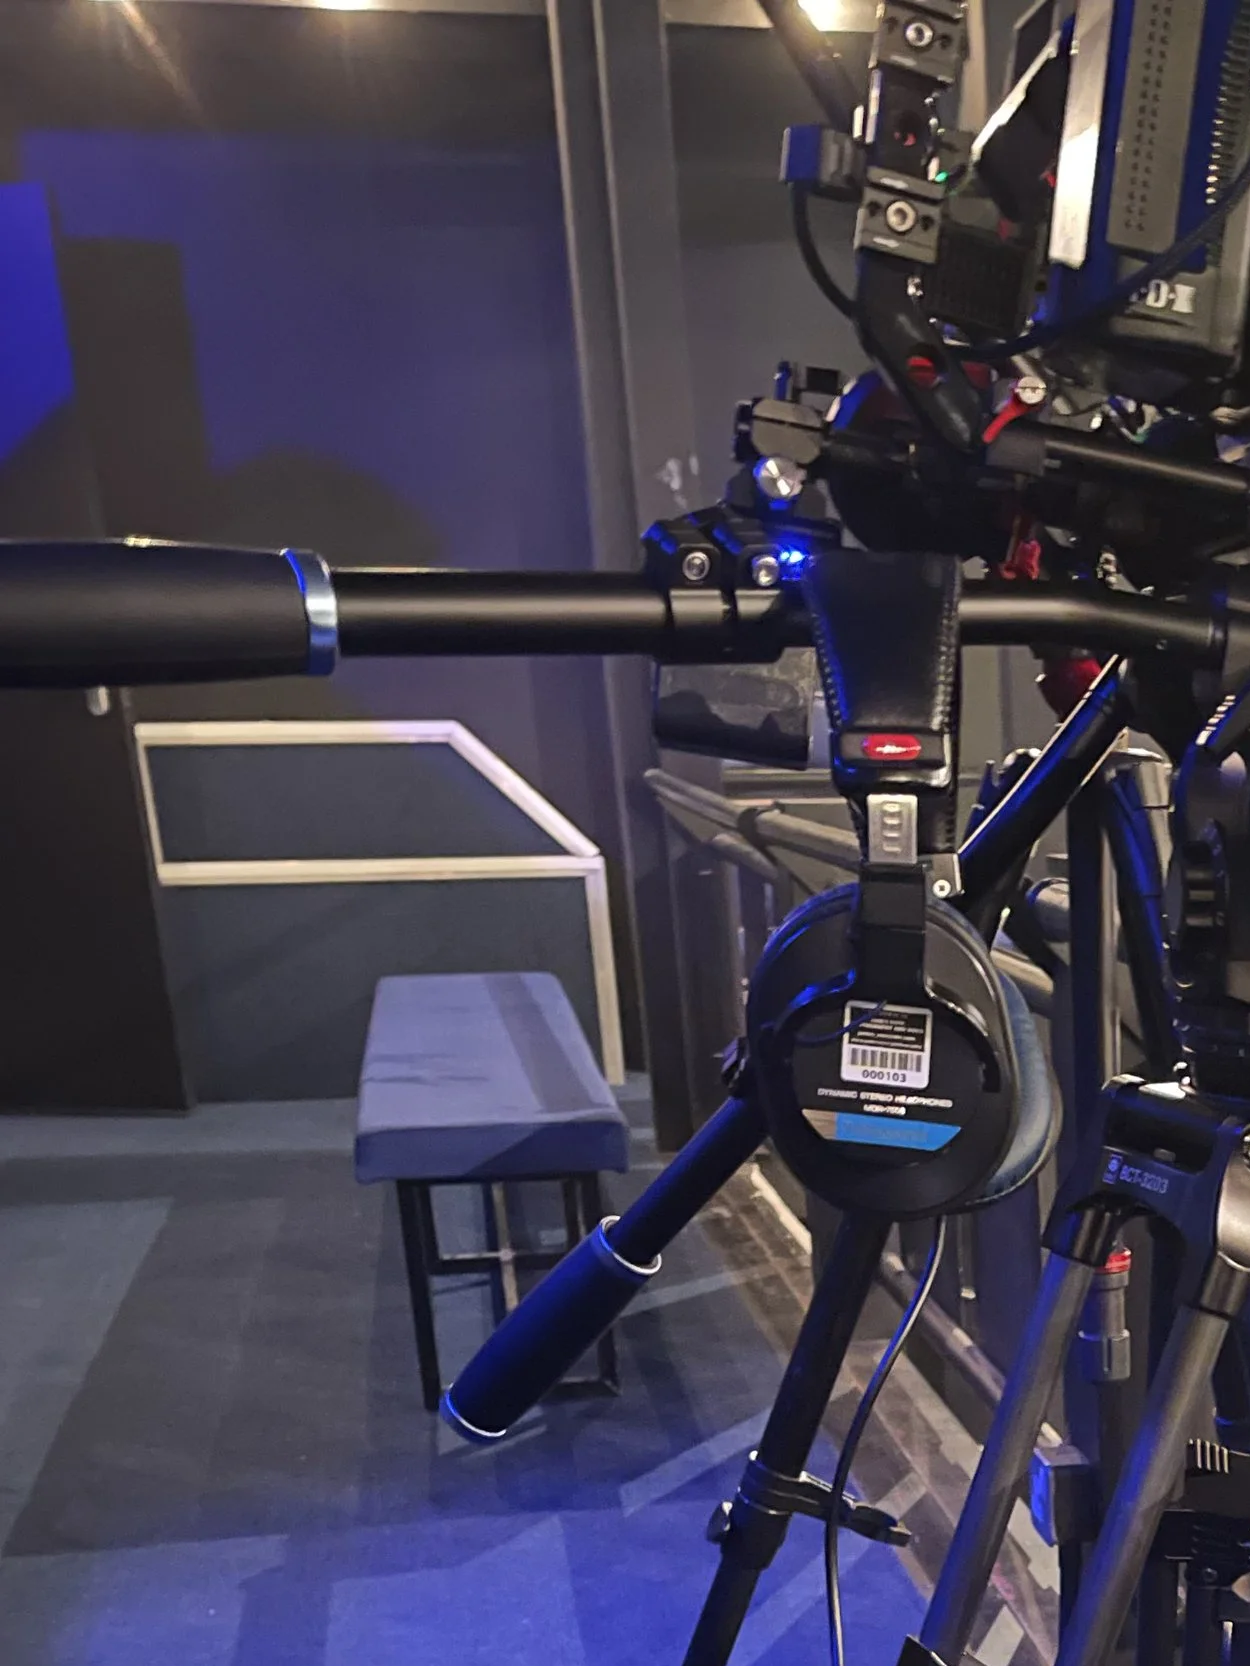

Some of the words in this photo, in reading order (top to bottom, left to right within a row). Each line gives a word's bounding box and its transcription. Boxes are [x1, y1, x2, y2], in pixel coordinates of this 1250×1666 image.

[861, 1069, 907, 1083] 000103
[817, 1088, 858, 1099] DYNAMIC
[859, 1091, 893, 1103] STEREO
[894, 1095, 953, 1108] HEADPHONES
